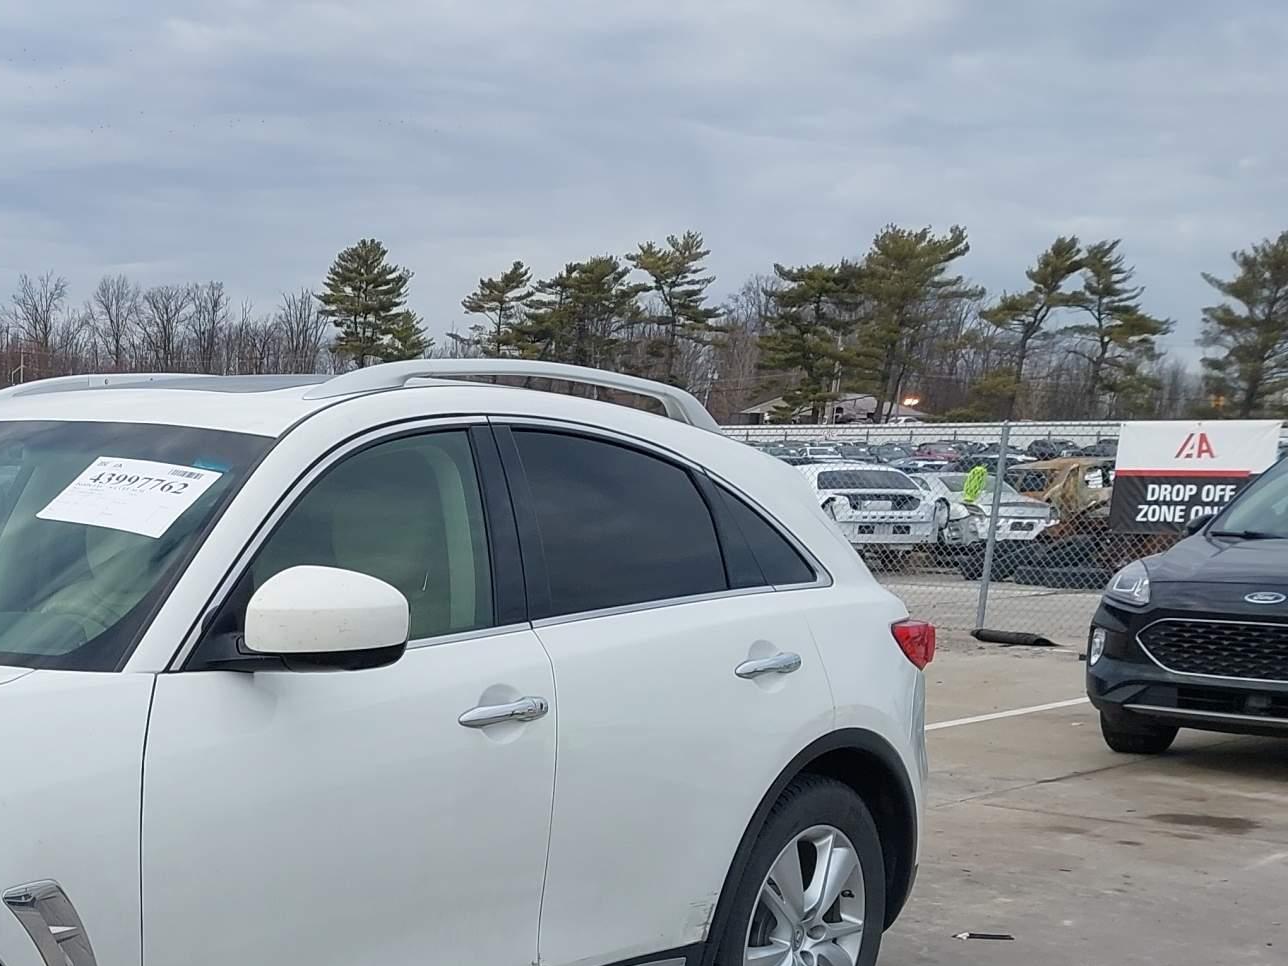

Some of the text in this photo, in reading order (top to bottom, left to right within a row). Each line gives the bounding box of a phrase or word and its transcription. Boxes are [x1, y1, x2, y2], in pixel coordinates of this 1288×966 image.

[89, 472, 189, 495] 43997762
[1146, 484, 1237, 502] DROP OFF
[1135, 505, 1186, 523] ZONE
